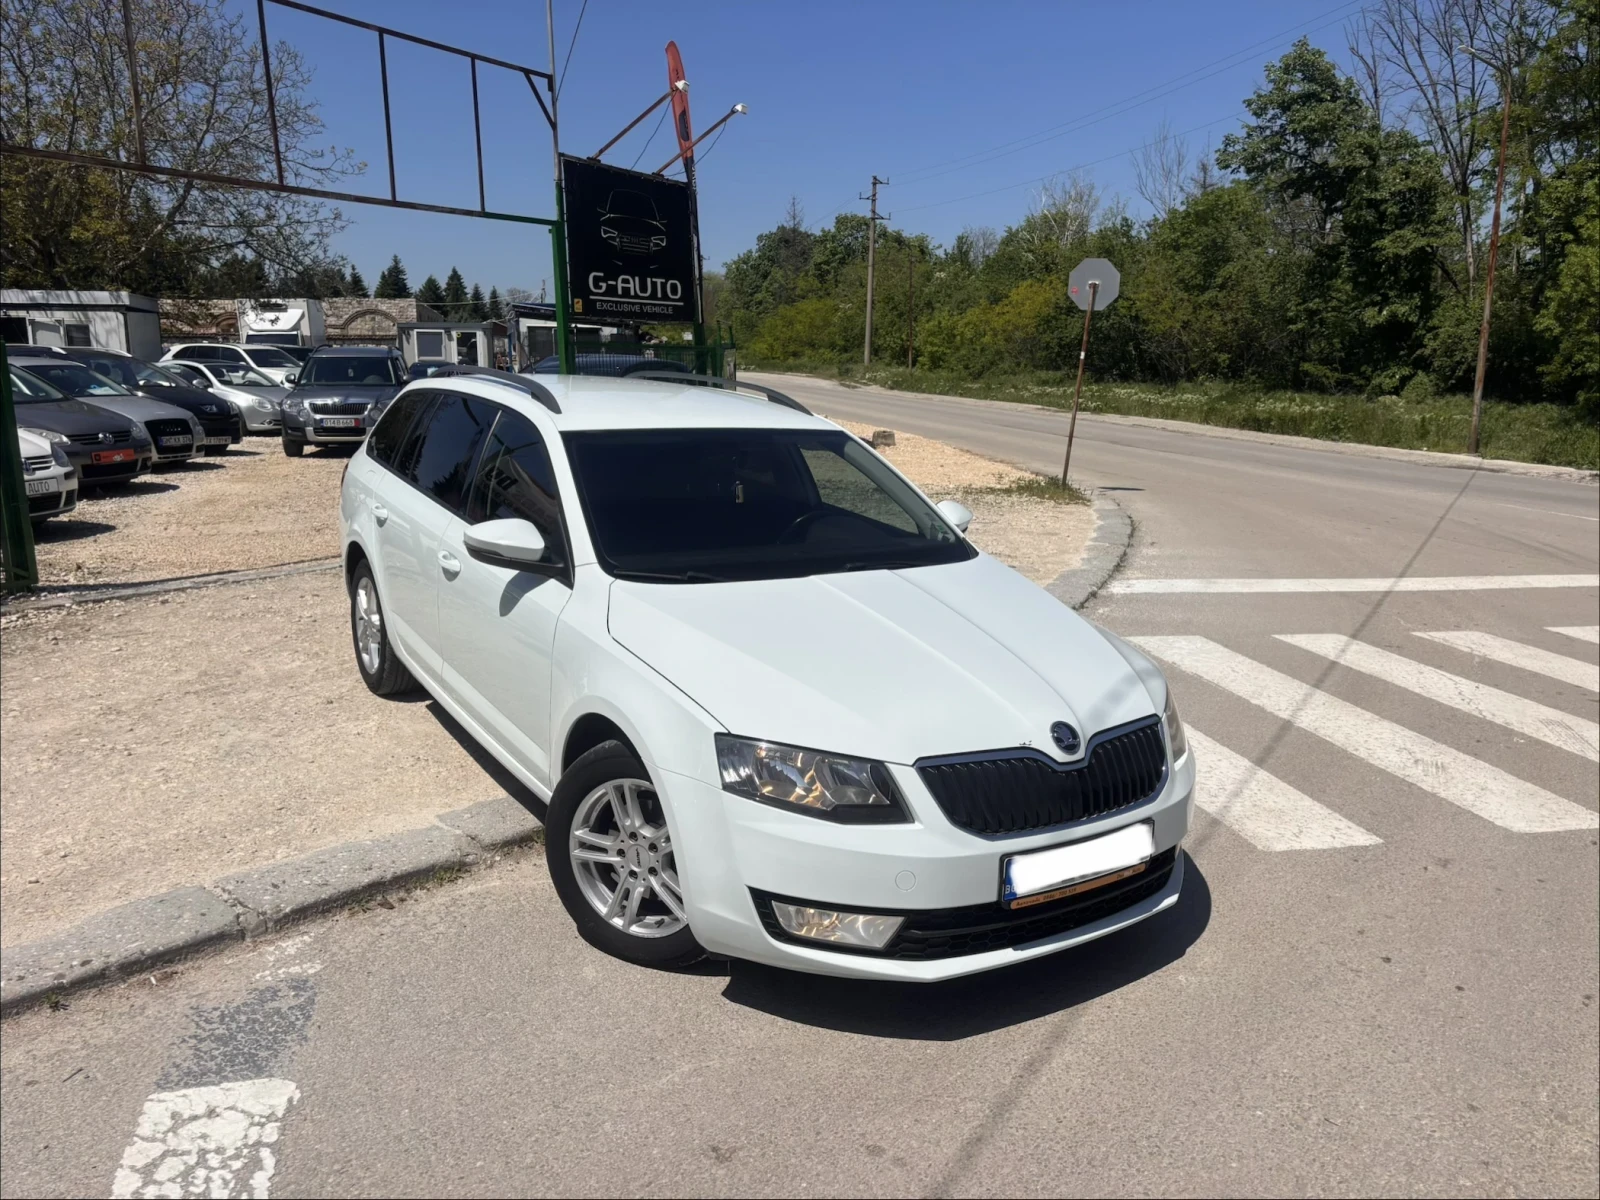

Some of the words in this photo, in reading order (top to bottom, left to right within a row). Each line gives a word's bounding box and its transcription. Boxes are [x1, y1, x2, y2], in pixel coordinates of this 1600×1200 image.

[588, 272, 682, 299] G-AUTO
[596, 301, 641, 313] EXCLUSIVE
[641, 305, 674, 315] VEHICLE
[28, 481, 50, 493] AUTO
